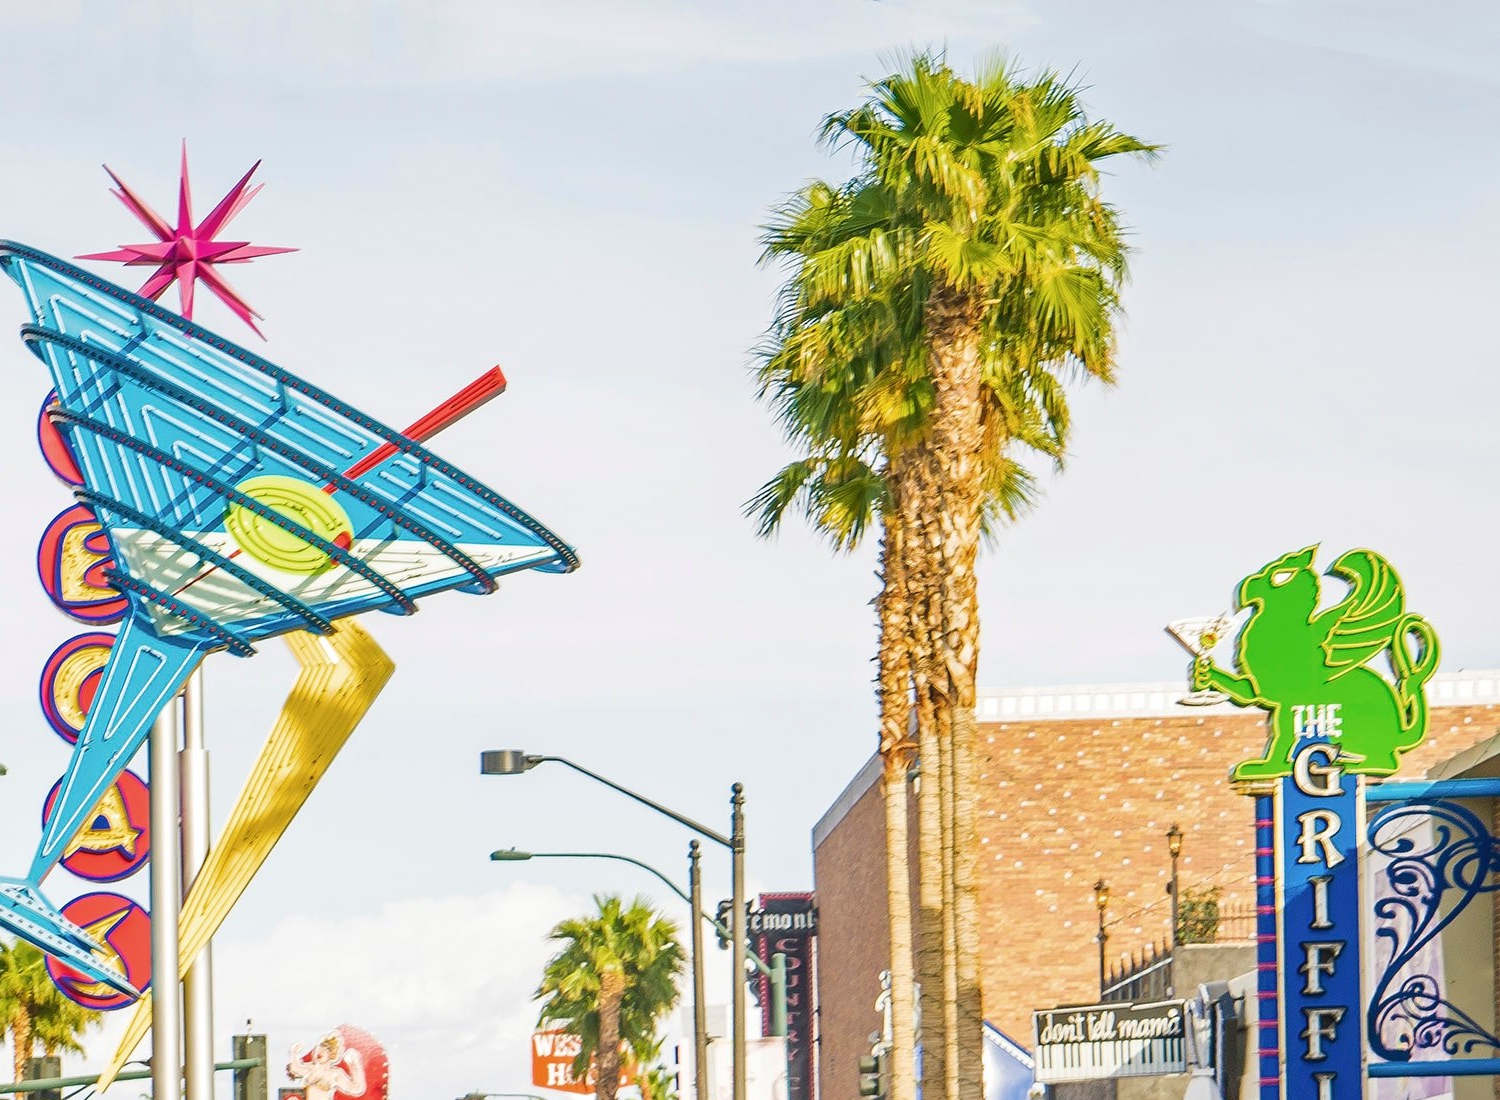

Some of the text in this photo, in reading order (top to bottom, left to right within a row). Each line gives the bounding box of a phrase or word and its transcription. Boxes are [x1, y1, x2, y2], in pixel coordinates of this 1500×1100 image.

[1290, 703, 1344, 738] THE
[1040, 1012, 1086, 1044] don't
[1086, 1010, 1118, 1041] tell
